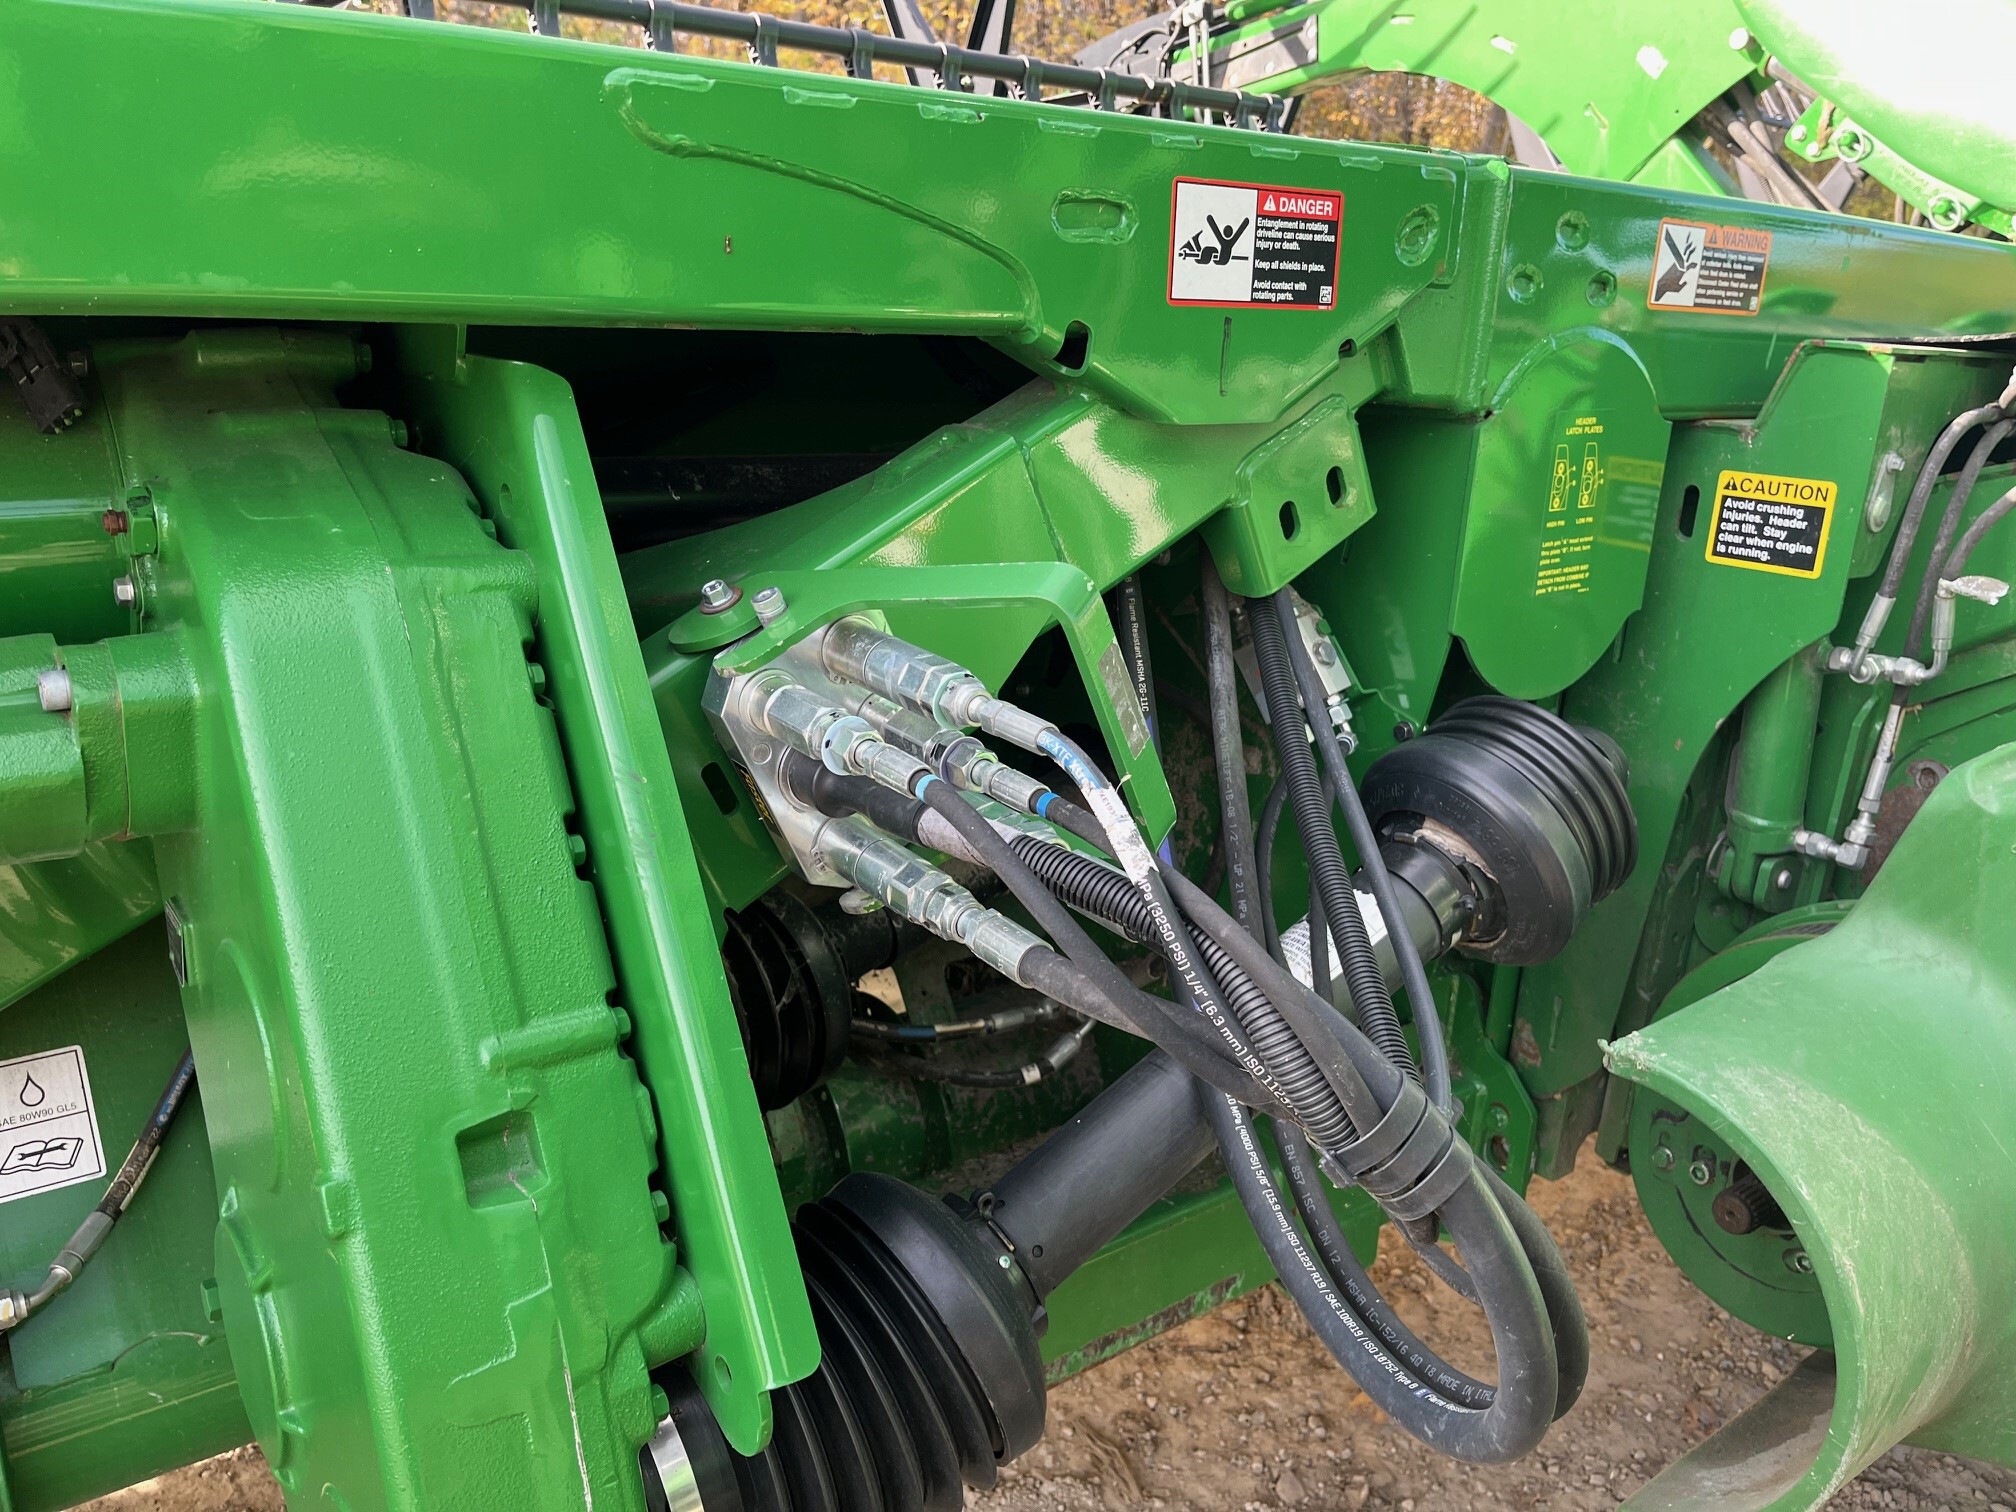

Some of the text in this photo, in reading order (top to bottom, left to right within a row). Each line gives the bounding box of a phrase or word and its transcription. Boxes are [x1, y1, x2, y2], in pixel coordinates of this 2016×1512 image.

[1279, 196, 1333, 216] DANGER
[1257, 217, 1329, 233] Entanglement in rotating
[1256, 229, 1335, 242] driveline can cause serious
[1282, 241, 1300, 250] death.
[1723, 230, 1768, 250] WARNING
[1255, 259, 1270, 271] Keep
[1280, 261, 1300, 270] shields
[1301, 262, 1307, 270] in
[1308, 262, 1326, 273] place.
[1253, 280, 1307, 291] Avoid contact with
[1253, 291, 1294, 302] rotating parts.
[1566, 425, 1604, 435] LATCH PLATES
[1575, 417, 1597, 425] HEADER
[1739, 477, 1829, 502] CAUTION
[1724, 497, 1805, 520] Avoid crushing
[1720, 521, 1788, 541] can tilt. Stay
[1768, 515, 1808, 530] Header
[1718, 532, 1813, 555] clear when engine
[1728, 546, 1770, 562] running.
[1128, 597, 1137, 622] Flame
[1131, 622, 1142, 659] Resistant
[1135, 660, 1146, 682] MSHA
[1138, 682, 1150, 712] 2G-11C
[1233, 863, 1243, 876] WP
[1235, 882, 1244, 894] 21
[1238, 899, 1248, 919] MPa
[1243, 1054, 1265, 1076] ISO
[19, 1107, 54, 1122] 80W90
[56, 1102, 77, 1114] GL5
[1230, 1104, 1243, 1126] MPa
[1286, 1230, 1300, 1246] ISO
[1294, 1245, 1317, 1272] 11237
[1310, 1271, 1327, 1290] R19
[1325, 1293, 1342, 1309] SAE
[1336, 1308, 1364, 1337] 100R19
[1362, 1340, 1379, 1354] ISO
[1373, 1351, 1399, 1374] 18752
[1394, 1370, 1412, 1385] Type
[1408, 1382, 1419, 1390] B
[1284, 1144, 1297, 1161] EN
[1291, 1165, 1306, 1186] 857
[1318, 1229, 1332, 1247] DN
[1329, 1250, 1341, 1265] 12
[1345, 1278, 1367, 1307] MSHA
[1365, 1307, 1409, 1355] IC-152/16
[1424, 1364, 1437, 1377] 18
[1436, 1372, 1461, 1391] MADE
[1461, 1385, 1475, 1397] IN
[1424, 1393, 1447, 1407] Flame
